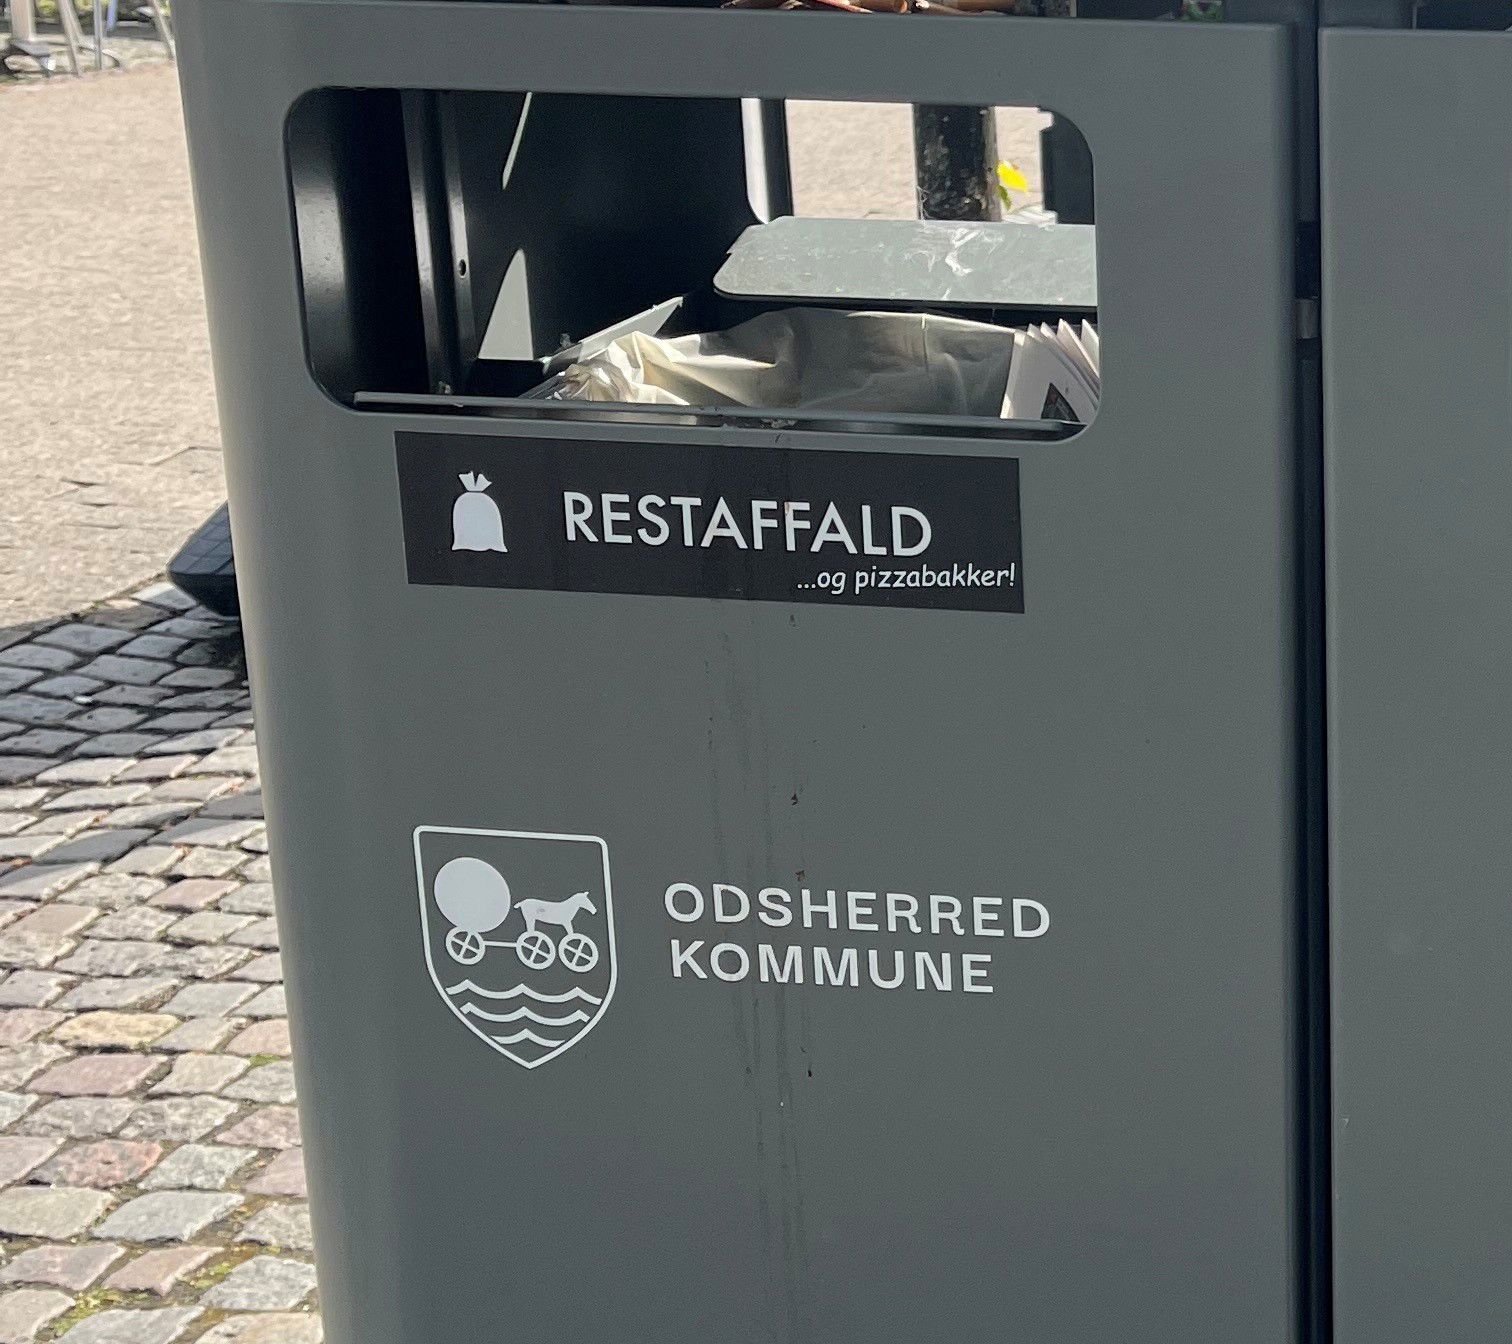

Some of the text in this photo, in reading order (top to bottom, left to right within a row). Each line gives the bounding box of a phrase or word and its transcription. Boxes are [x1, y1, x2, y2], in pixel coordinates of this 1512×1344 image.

[563, 491, 932, 557] RESTAFFALD
[796, 562, 1016, 595] ...og pizzabakker!
[664, 882, 1051, 938] ODSHERRED
[670, 939, 995, 994] KOMMUNE
